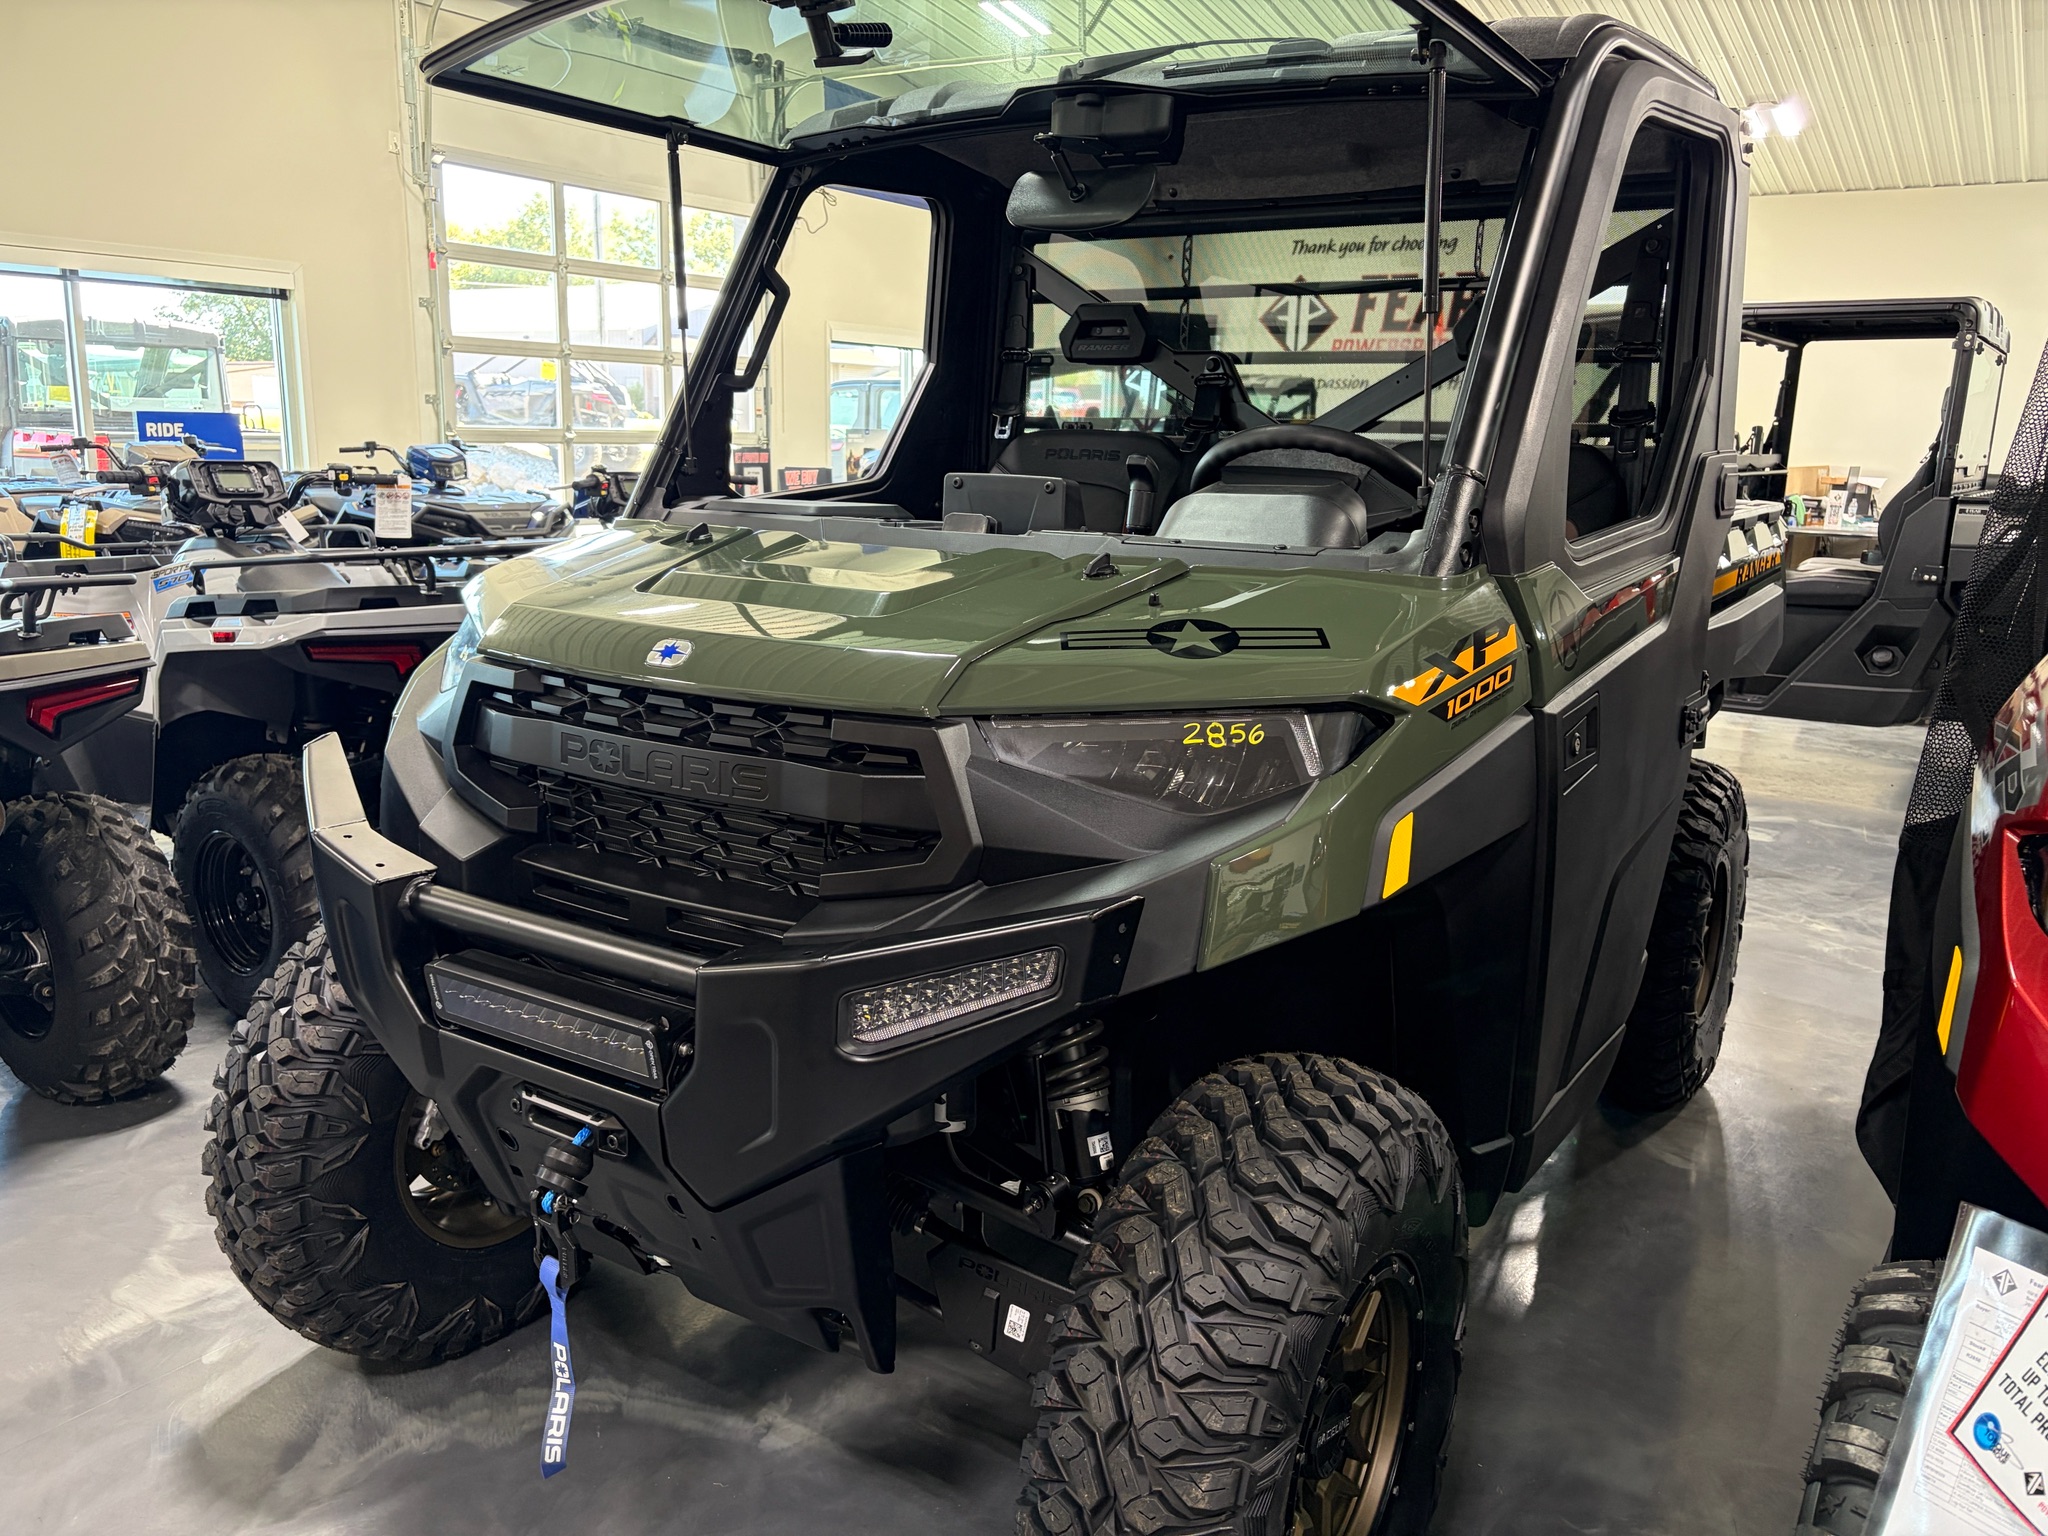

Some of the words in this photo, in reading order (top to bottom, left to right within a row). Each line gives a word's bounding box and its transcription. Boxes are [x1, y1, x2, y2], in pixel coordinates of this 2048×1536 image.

[1292, 237, 1337, 255] Thank
[1338, 242, 1365, 259] you
[1368, 235, 1390, 254] for
[1391, 234, 1459, 255] choong
[1044, 447, 1121, 461] POLARIS
[784, 470, 801, 486] WE
[801, 469, 819, 485] BUY
[158, 572, 190, 588] 570
[1736, 552, 1779, 587] RANGER
[1419, 616, 1512, 703] XP
[1447, 664, 1513, 720] 1000
[1183, 721, 1265, 748] 2856
[560, 731, 770, 802] POLARIS
[2021, 1367, 2042, 1387] UP
[544, 1341, 572, 1464] POLARIS
[1998, 1372, 2033, 1417] TOTAL
